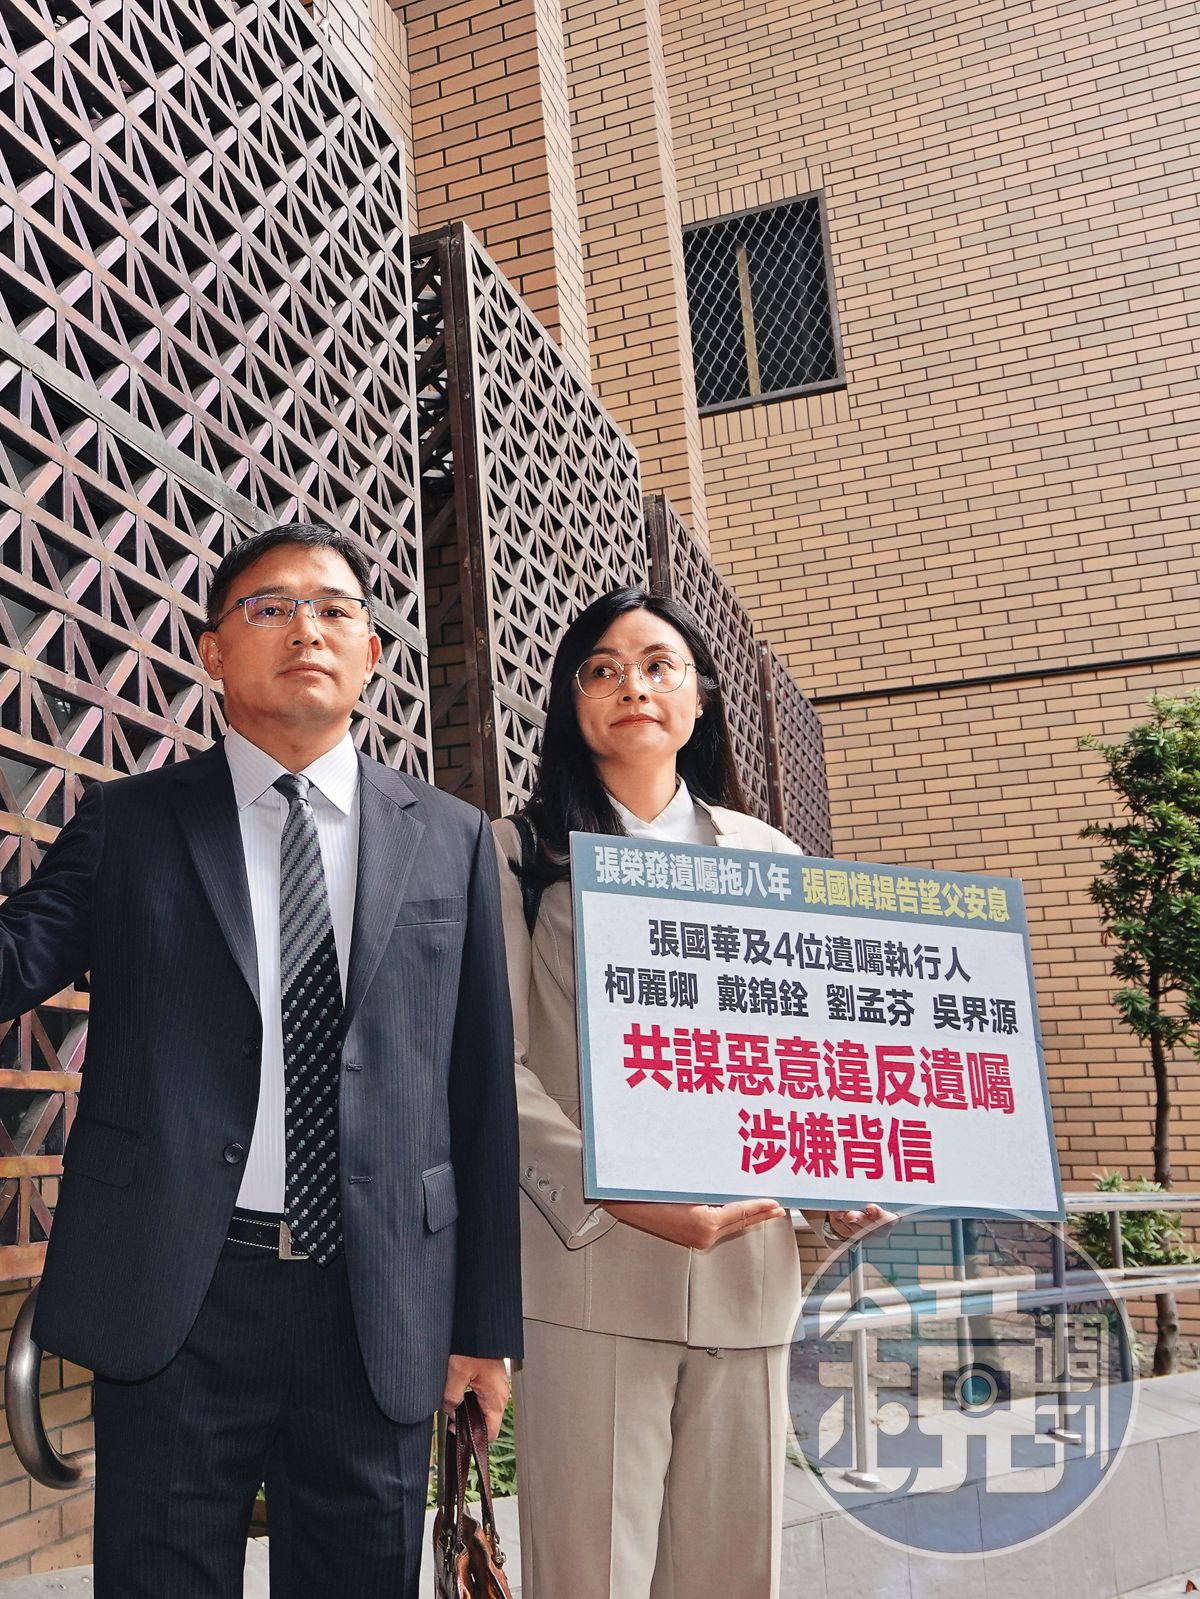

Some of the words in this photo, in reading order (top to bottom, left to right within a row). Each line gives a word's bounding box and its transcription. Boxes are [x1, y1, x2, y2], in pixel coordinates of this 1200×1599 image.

[595, 845, 792, 902] 張榮發遺囑拖八年
[801, 866, 1010, 923] 張國煒提告望父安息
[648, 919, 972, 984] 張國華及4位遺囑執行人
[604, 964, 698, 1010] 柯麗卿
[717, 974, 809, 1019] 戴錦銓
[827, 983, 915, 1027] 劉孟芬
[933, 994, 1019, 1035] 吳界源
[623, 1022, 1015, 1115] 共謀惡意違反遺囑
[738, 1107, 936, 1184] 涉嫌背信
